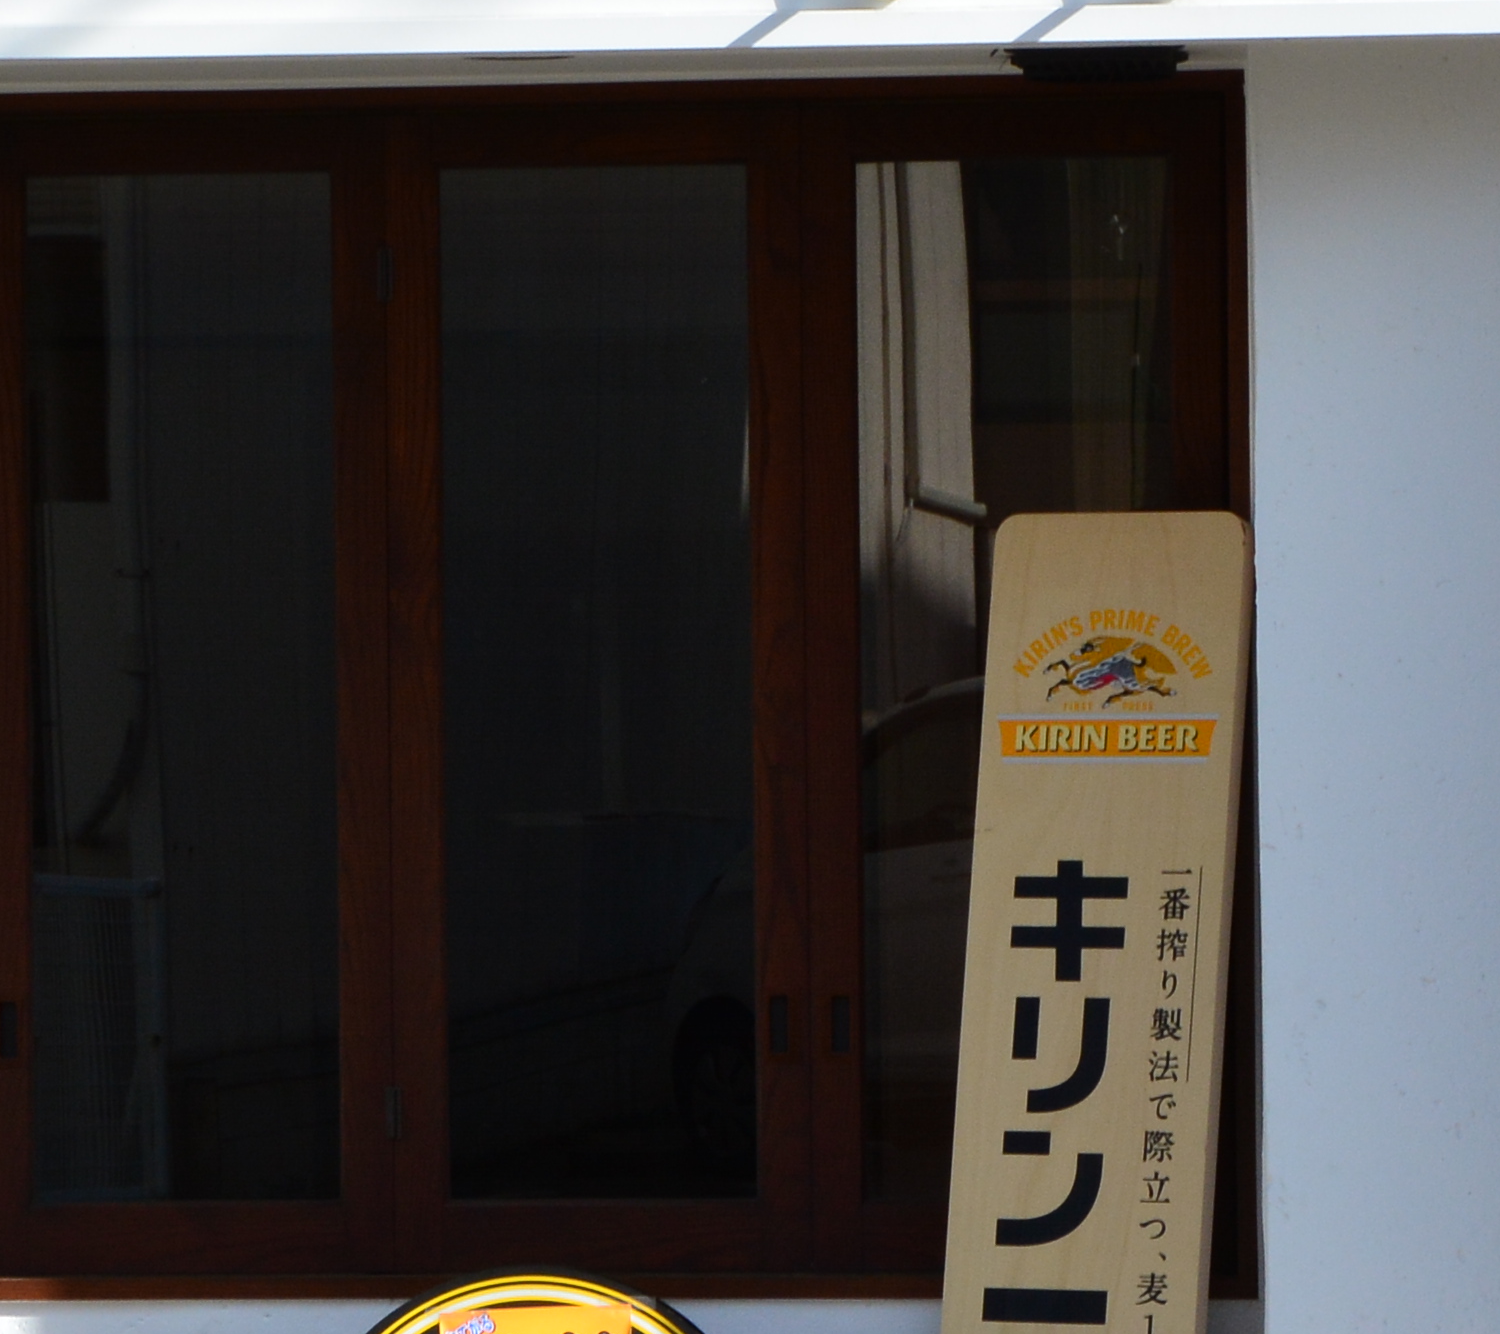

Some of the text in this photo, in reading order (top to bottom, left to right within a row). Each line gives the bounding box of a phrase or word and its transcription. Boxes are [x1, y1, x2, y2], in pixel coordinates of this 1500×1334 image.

[1012, 608, 1213, 680] KIRIN'S PRIME BREW
[1014, 724, 1199, 753] KIRIN BEER
